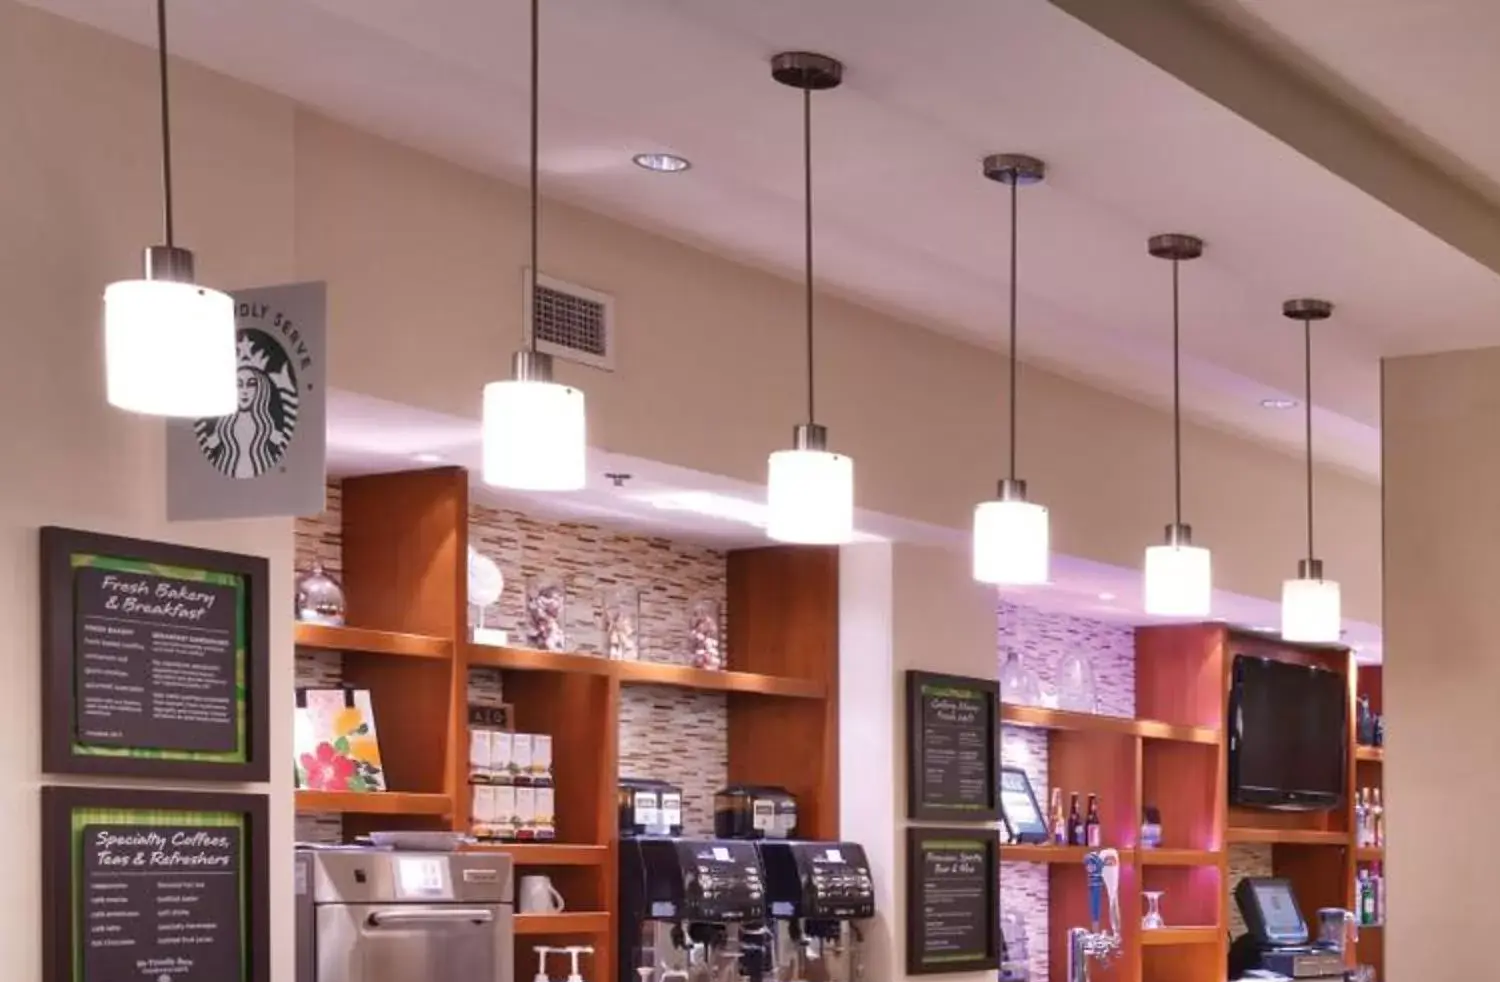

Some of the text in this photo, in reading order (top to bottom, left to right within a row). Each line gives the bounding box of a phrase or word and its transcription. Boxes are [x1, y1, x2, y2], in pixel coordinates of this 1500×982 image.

[235, 303, 311, 371] DLY SERVE
[103, 575, 215, 608] Fresh Bakery
[104, 595, 205, 620] & Breakfast
[95, 831, 230, 850] Specialty Coffees,
[97, 850, 230, 866] Teas & Refreshers
